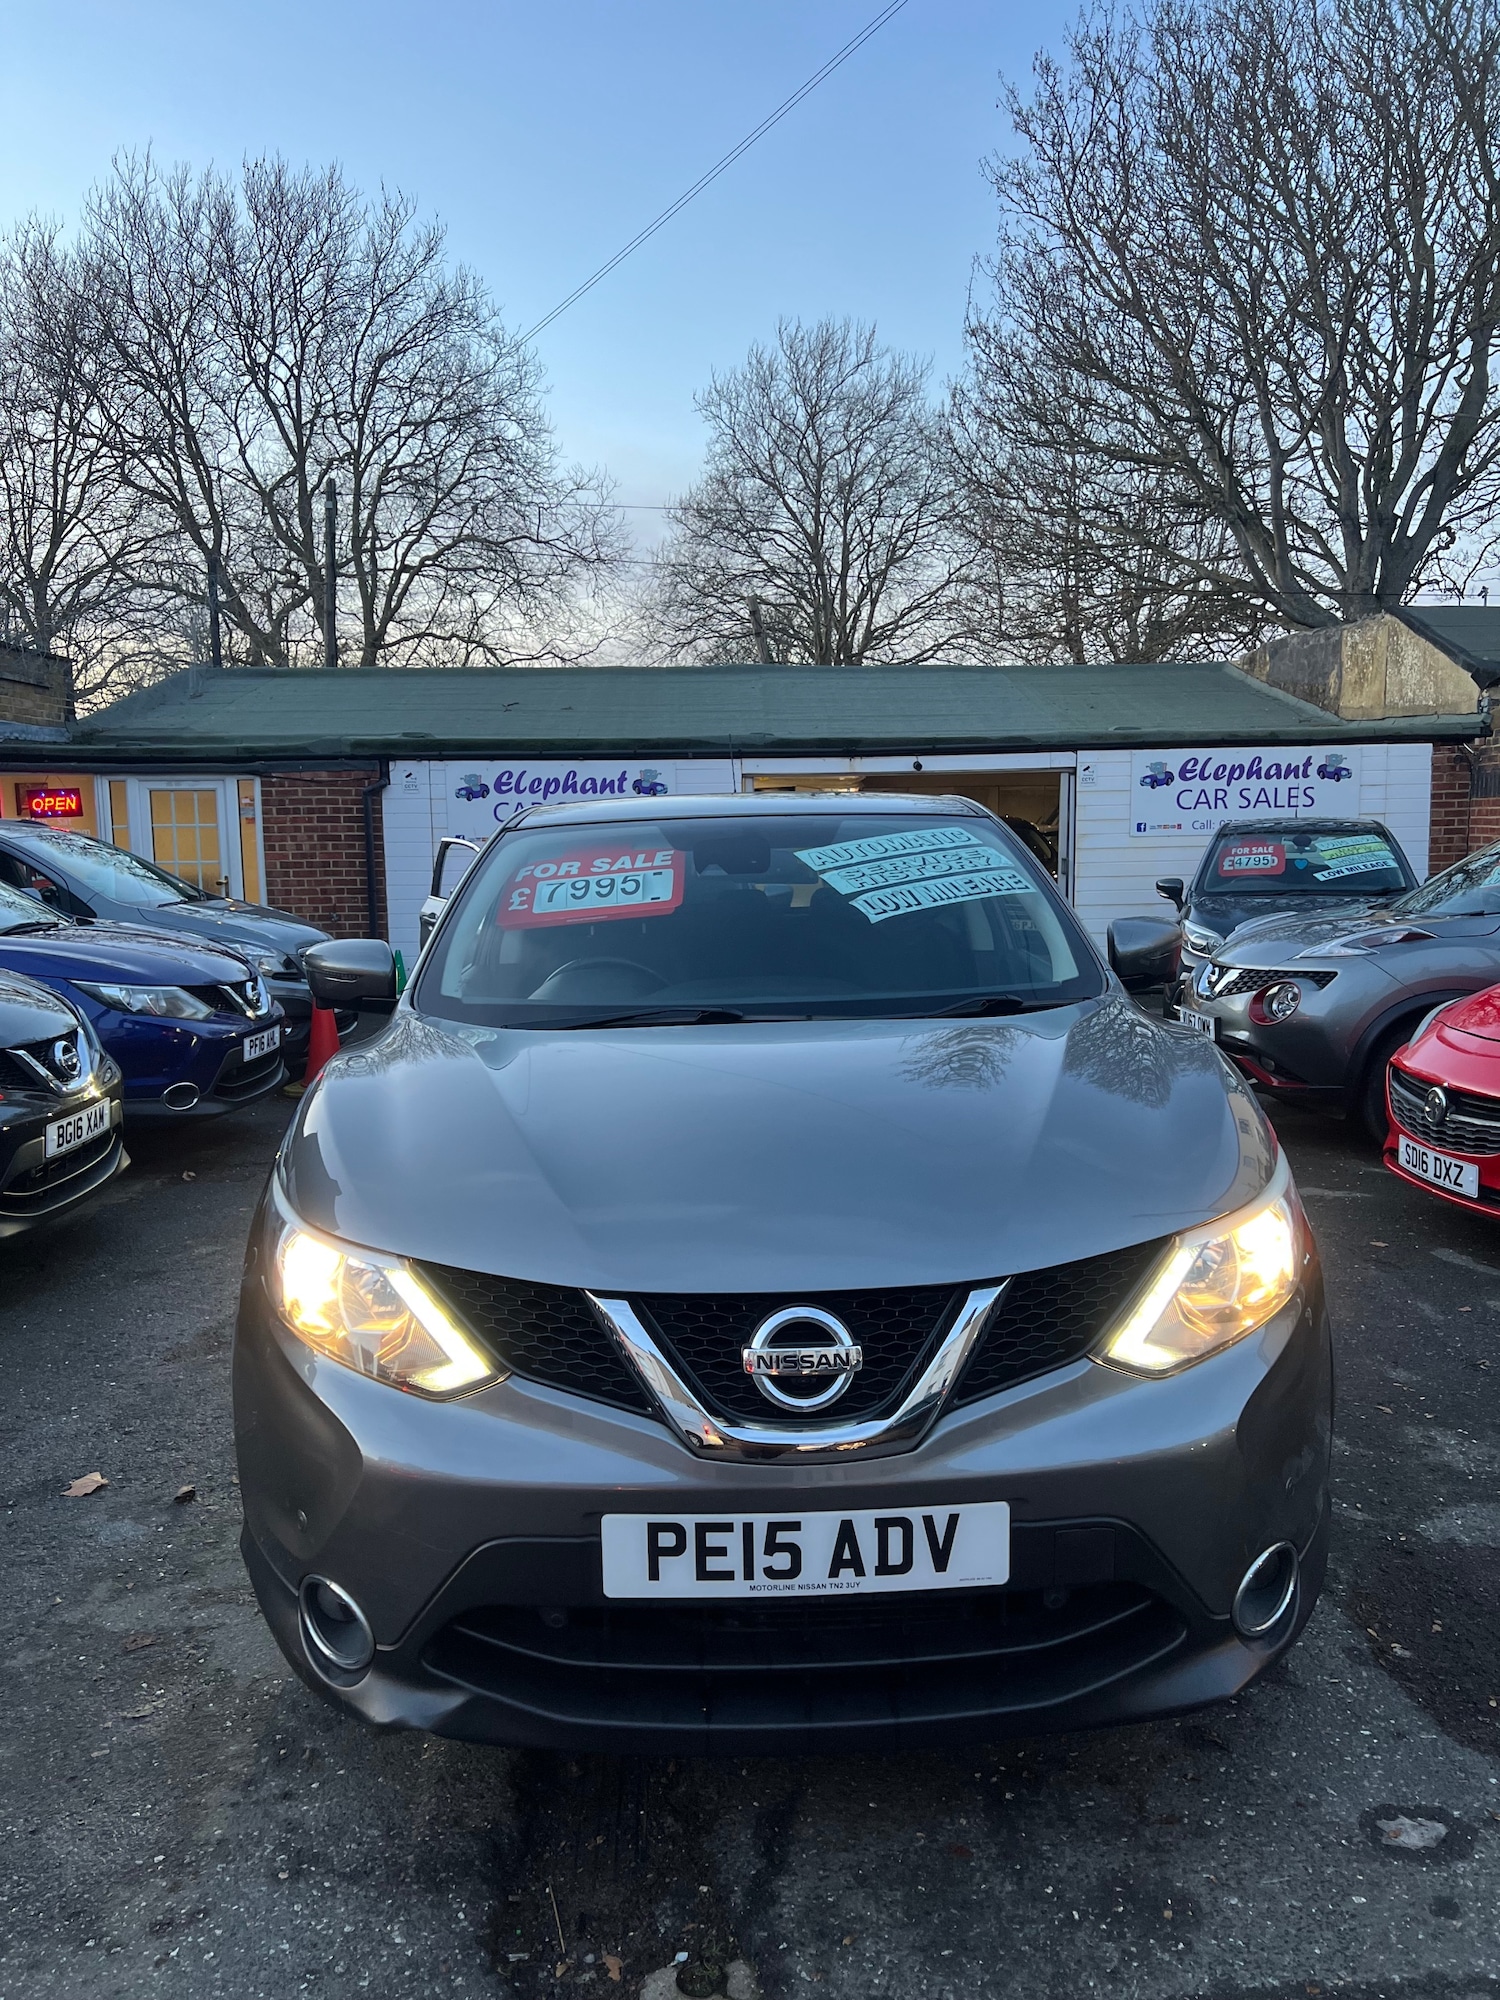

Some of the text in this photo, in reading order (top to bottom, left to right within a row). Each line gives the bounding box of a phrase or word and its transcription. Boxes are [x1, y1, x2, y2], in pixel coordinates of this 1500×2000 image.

[493, 770, 627, 800] Elephant
[1178, 756, 1313, 787] Elephant
[32, 797, 76, 811] OPEN
[1176, 786, 1315, 810] CAR SALES
[1191, 820, 1215, 830] Call:
[808, 830, 971, 866] AUTOMATIC
[838, 849, 979, 878] SERVICE
[515, 851, 674, 882] FOR SALE
[851, 855, 993, 889] HISTORY
[1321, 860, 1391, 879] LOW MILEAGE
[863, 872, 1030, 915] LOW MILEAGE
[57, 1105, 104, 1148] BG16 XAM
[1405, 1144, 1464, 1188] SD16 DXZ
[757, 1352, 850, 1370] NISSAN
[647, 1513, 960, 1582] PE15 ADV
